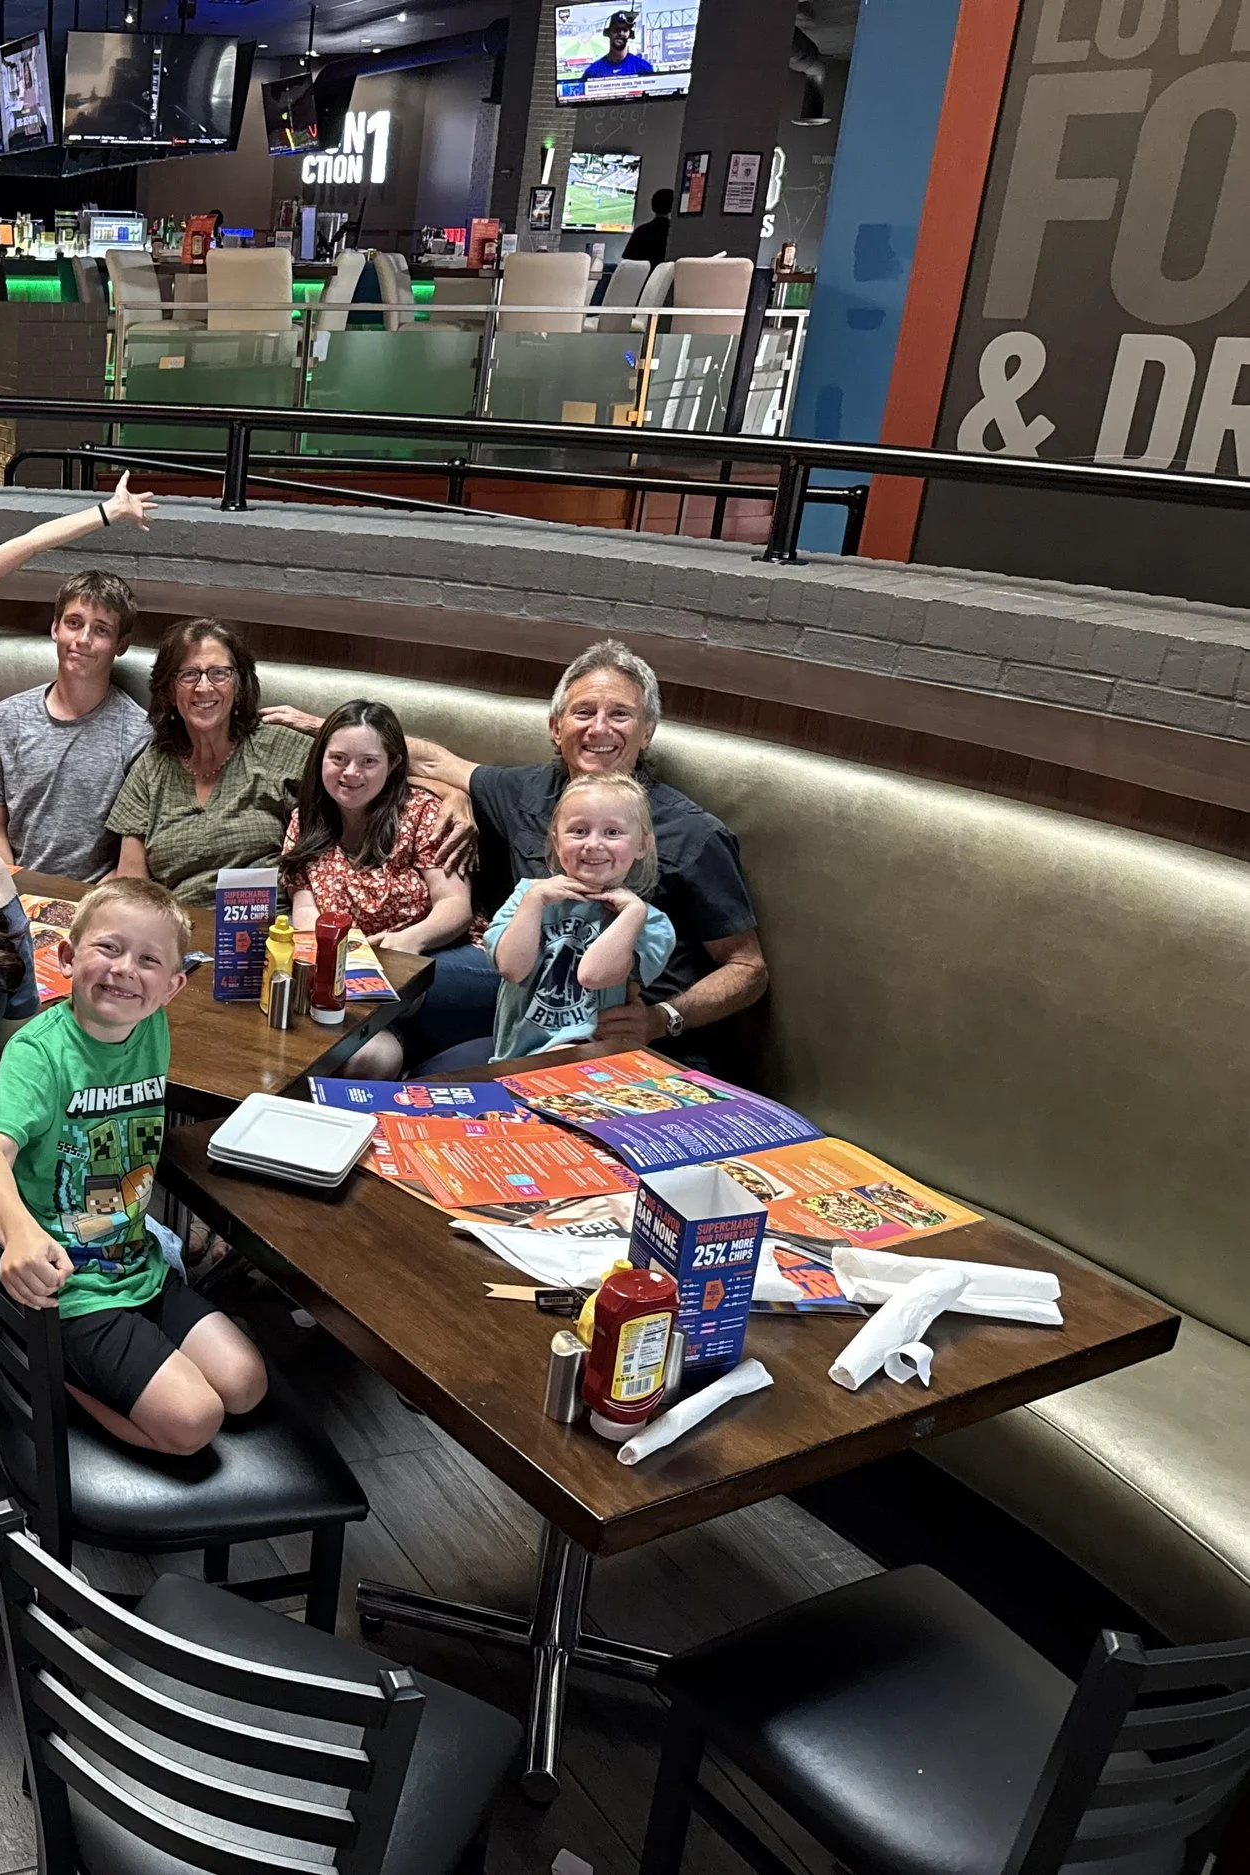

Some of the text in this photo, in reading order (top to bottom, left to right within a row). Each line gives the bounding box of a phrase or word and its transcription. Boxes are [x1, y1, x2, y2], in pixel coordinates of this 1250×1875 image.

[366, 110, 390, 184] 1
[302, 154, 363, 184] CTION
[957, 331, 1055, 458] &
[224, 891, 270, 899] SUPERCHARGE
[223, 905, 248, 921] 25%
[251, 904, 269, 912] MORE
[531, 1006, 585, 1029] BEACH
[67, 1075, 165, 1114] MINECRA
[636, 1200, 679, 1254] BAR NONE.
[695, 1228, 758, 1244] YOUR POWER CARD
[696, 1217, 759, 1236] SUPERCHARGE
[692, 1242, 728, 1267] 25%
[731, 1237, 755, 1251] MORE
[728, 1249, 753, 1262] CHIPS
